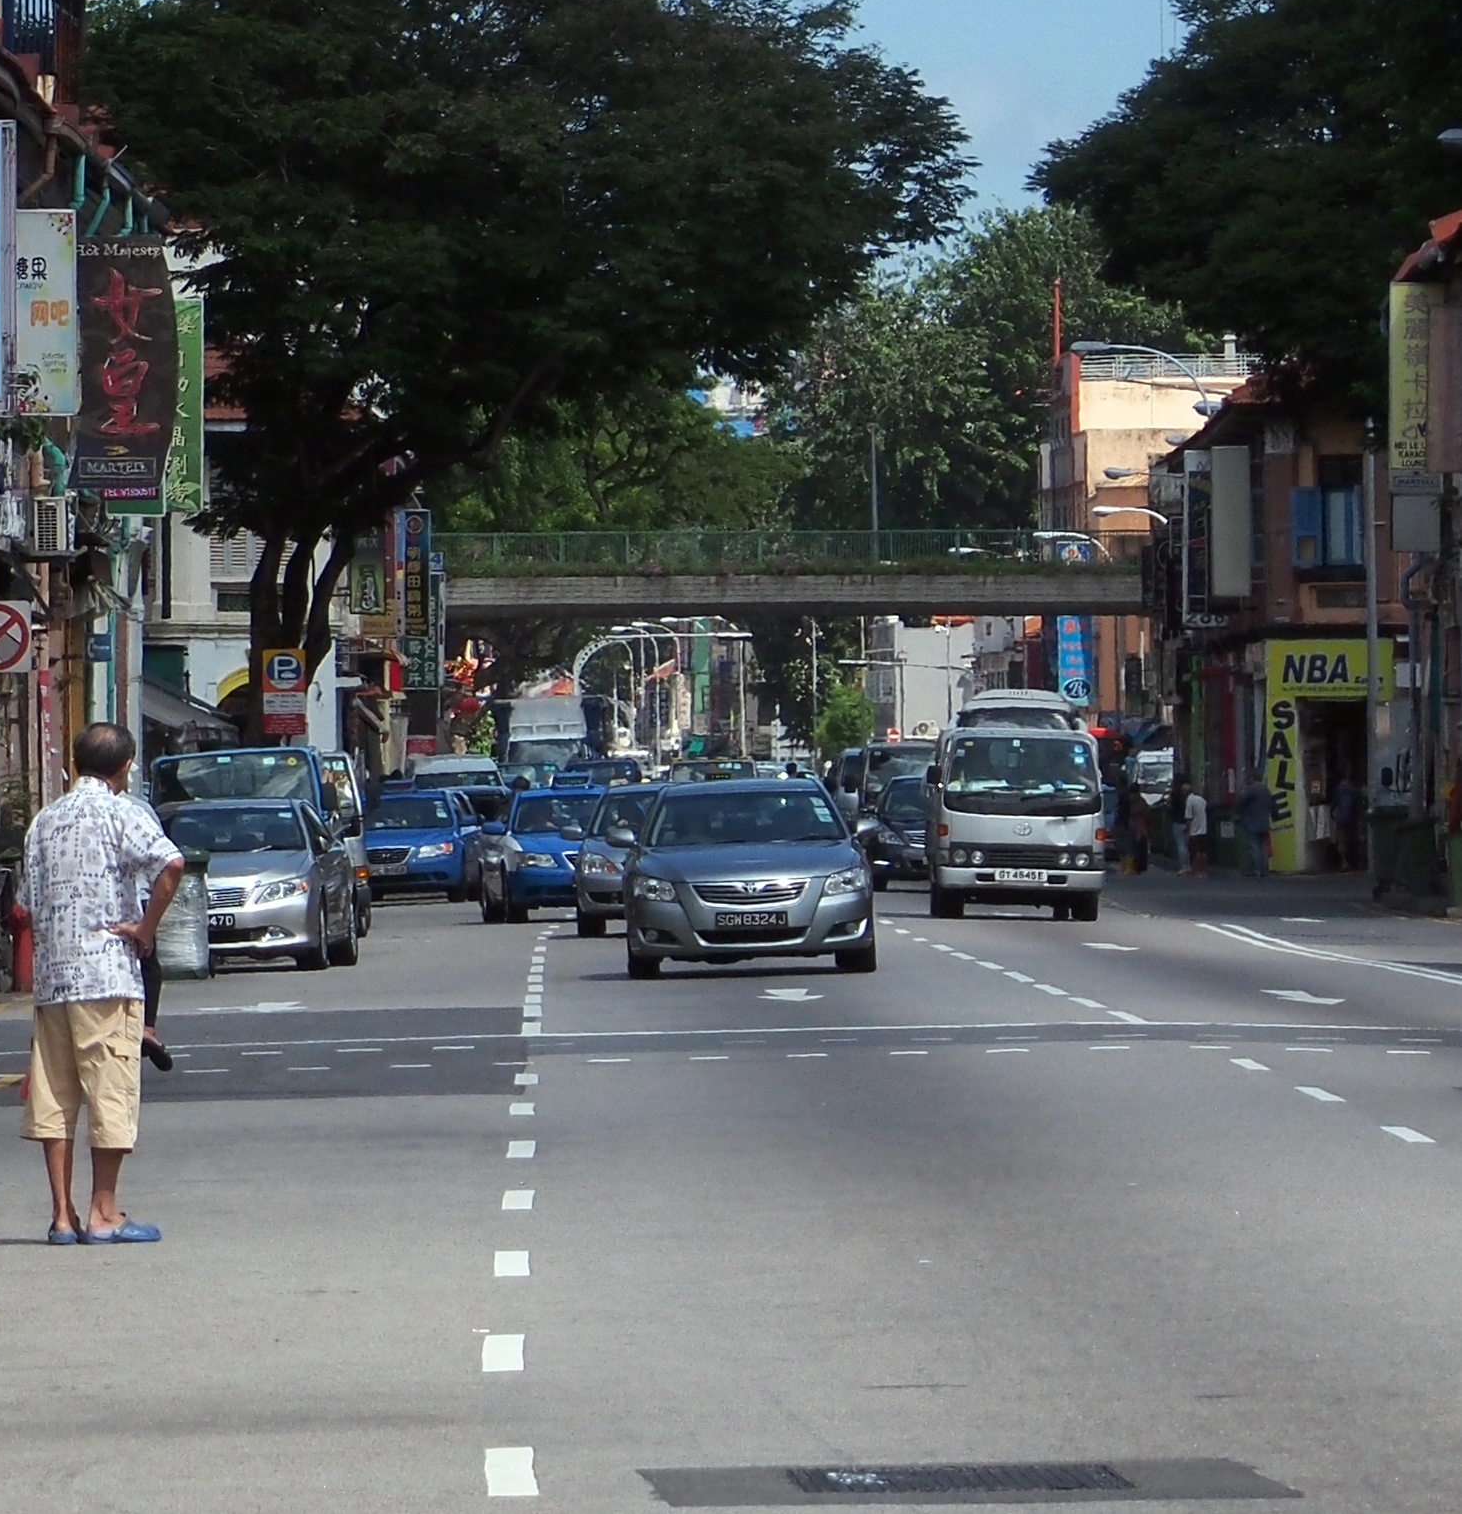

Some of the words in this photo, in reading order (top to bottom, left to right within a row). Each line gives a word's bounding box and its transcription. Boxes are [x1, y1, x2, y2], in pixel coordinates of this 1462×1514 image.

[30, 299, 70, 327] 网吧
[90, 266, 164, 435] 女皇
[274, 656, 298, 680] P
[1282, 653, 1349, 684] NBA
[1267, 699, 1296, 823] SALE
